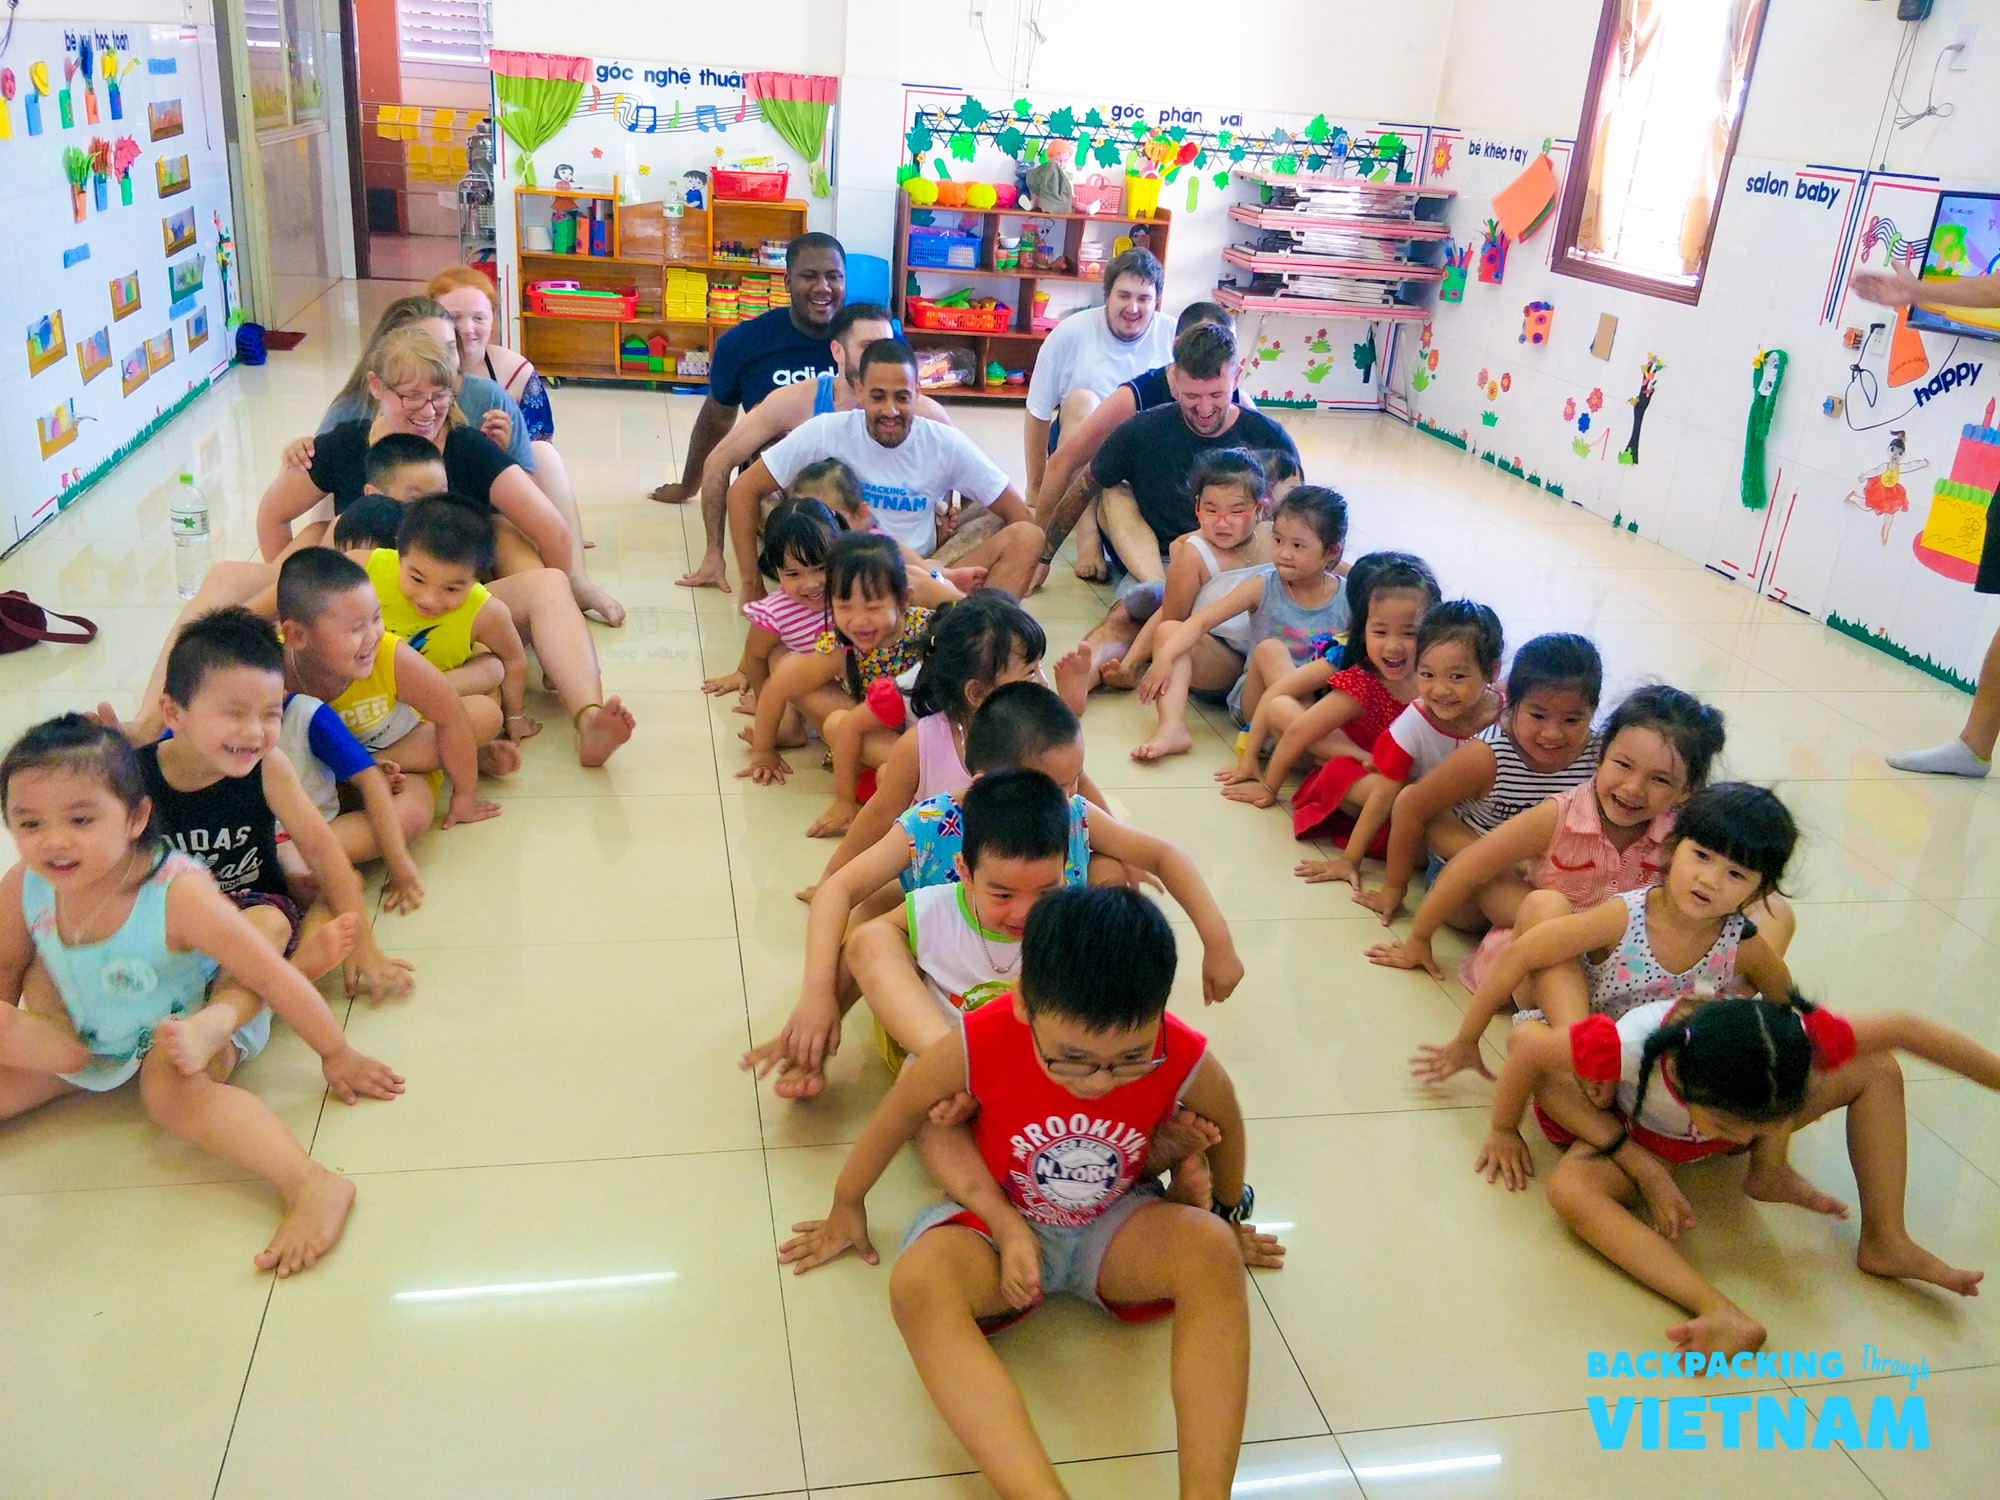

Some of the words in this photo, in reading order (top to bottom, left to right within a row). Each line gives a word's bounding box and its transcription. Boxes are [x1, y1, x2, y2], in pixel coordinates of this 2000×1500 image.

[596, 61, 634, 83] góc
[644, 67, 691, 90] nghệ
[1111, 103, 1145, 121] góc
[1159, 106, 1203, 125] phân
[1220, 112, 1243, 127] vai
[1468, 138, 1481, 156] bé
[1484, 141, 1507, 161] khéo
[1509, 145, 1528, 166] tay
[1745, 171, 1789, 197] salon
[1795, 178, 1840, 210] baby
[772, 366, 839, 386] adid
[1913, 362, 1983, 407] happy
[160, 826, 252, 853] IDAS
